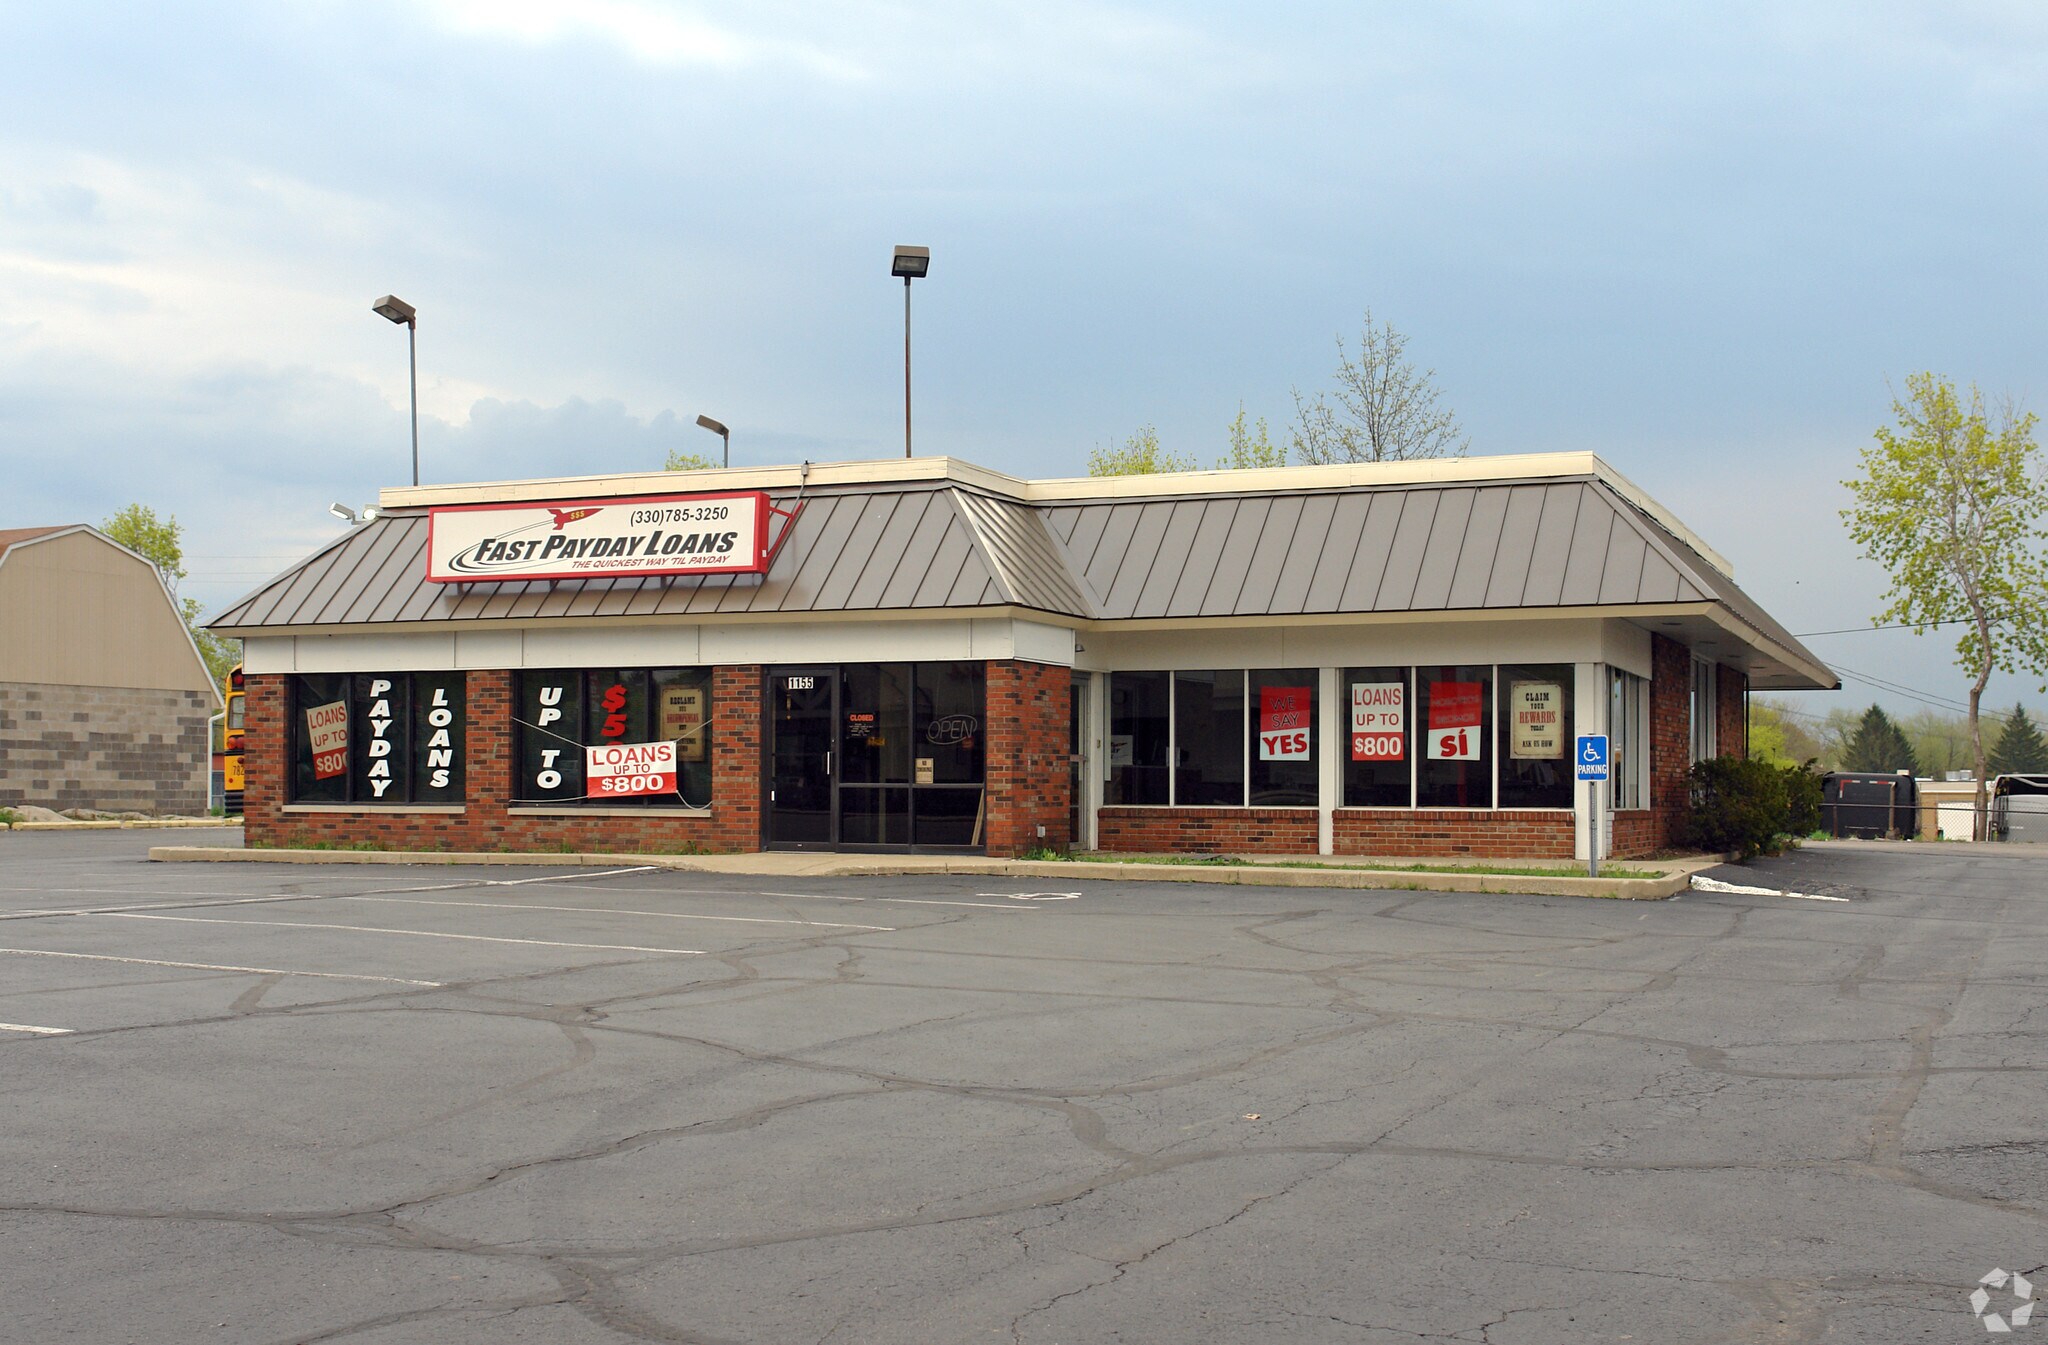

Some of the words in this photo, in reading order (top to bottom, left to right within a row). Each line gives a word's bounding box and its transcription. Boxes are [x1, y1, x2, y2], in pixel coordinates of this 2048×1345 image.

[630, 506, 729, 527] (330)785-3250
[473, 538, 542, 562] FAST
[539, 534, 647, 560] PAYDAY
[643, 530, 738, 556] LOANS
[571, 560, 592, 569] THE
[593, 558, 645, 568] QUICKEST
[645, 557, 669, 567] WAY
[688, 555, 731, 565] PAYDAY
[790, 677, 812, 689] 1155
[1270, 695, 1296, 711] WE
[1354, 687, 1401, 706] LOANS
[1525, 692, 1550, 702] CLAIM
[309, 705, 347, 729] LOANS
[601, 684, 628, 746] $5
[1271, 711, 1299, 729] SAY
[1356, 713, 1376, 726] UP
[1379, 713, 1400, 726] TO
[1519, 710, 1556, 724] REWARDS
[314, 733, 329, 748] UP
[331, 729, 347, 743] TO
[367, 679, 393, 798] PAYDAY
[427, 688, 453, 788] LOANS
[928, 720, 974, 739] OPEN
[1262, 733, 1308, 756] YES
[1354, 736, 1401, 756] $800
[1440, 728, 1468, 758] SÍ
[1522, 740, 1532, 748] ASK
[1541, 740, 1553, 748] HOW
[592, 745, 672, 766] LOANS
[613, 765, 630, 775] UP
[633, 763, 651, 773] TO
[1578, 764, 1607, 775] PARKING
[601, 774, 664, 793] $800
